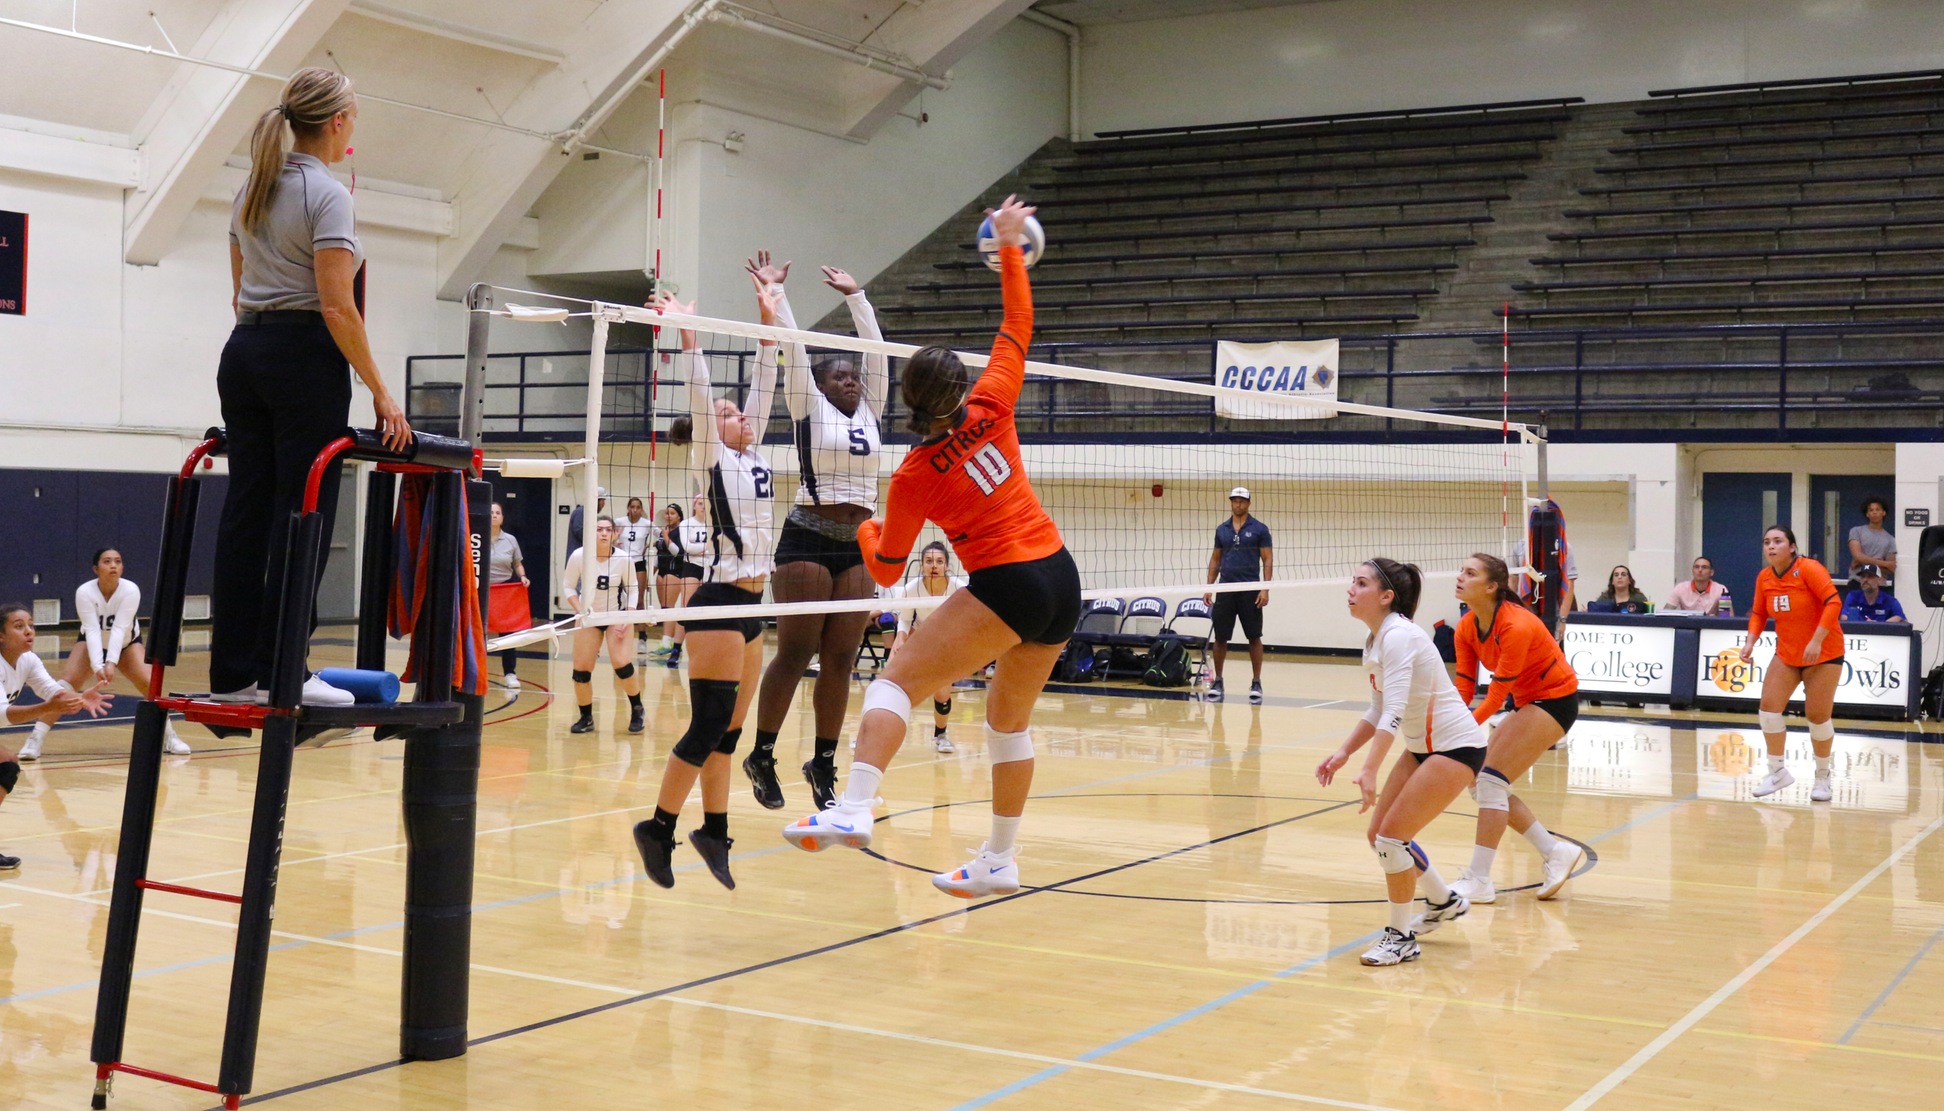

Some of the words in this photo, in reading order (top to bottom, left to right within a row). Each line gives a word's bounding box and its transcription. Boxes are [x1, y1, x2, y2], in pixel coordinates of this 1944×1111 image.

[1221, 365, 1307, 392] CCCAA
[848, 428, 871, 456] 5
[929, 418, 996, 474] CITRUS
[963, 441, 1012, 497] 10
[628, 531, 636, 542] 3
[695, 531, 708, 543] 17
[596, 575, 610, 590] 8
[1132, 599, 1161, 613] CITRUS
[1566, 631, 1605, 644] OME
[1610, 632, 1634, 645] TO
[1571, 650, 1663, 687] College
[1702, 655, 1764, 693] Figh
